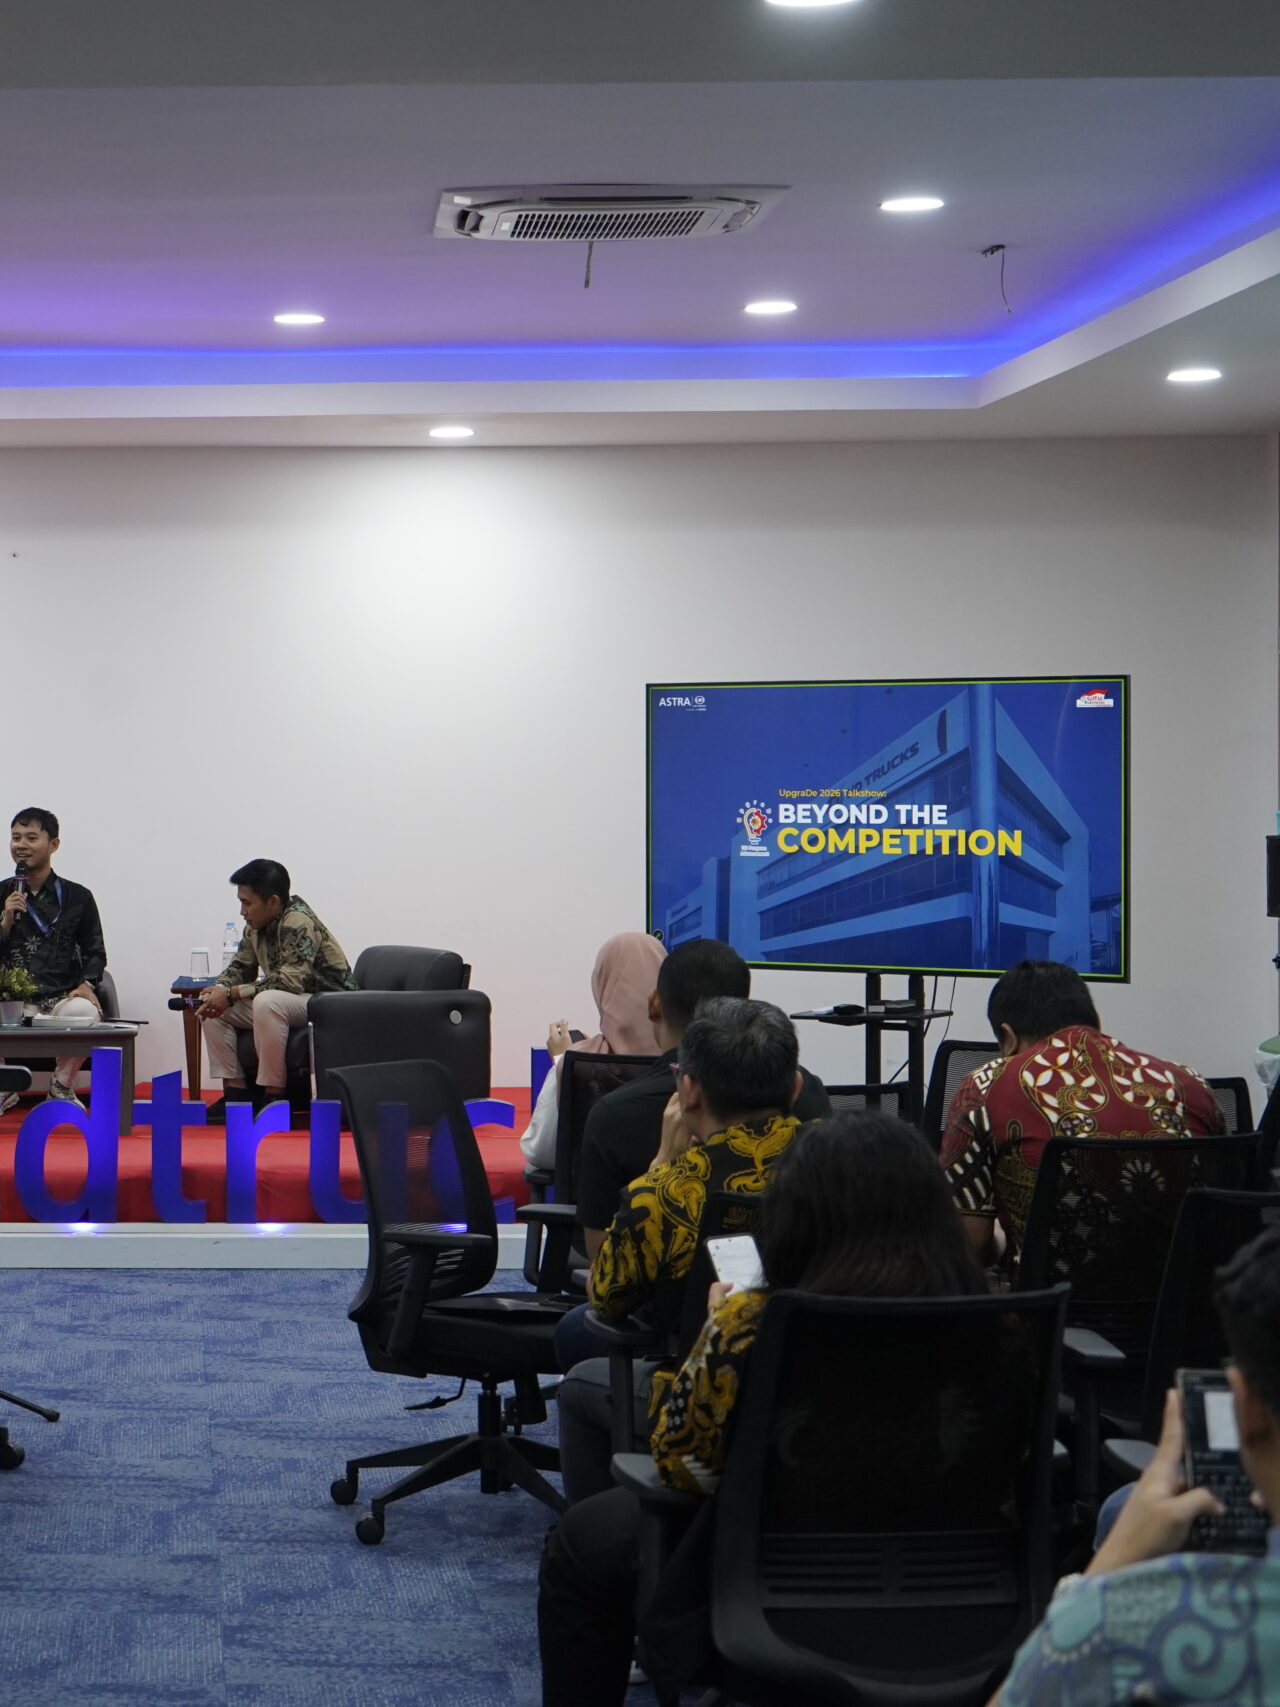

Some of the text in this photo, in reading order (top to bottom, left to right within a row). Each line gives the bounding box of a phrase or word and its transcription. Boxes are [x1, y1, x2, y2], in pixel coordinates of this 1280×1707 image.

[659, 697, 691, 707] ASTRA
[864, 741, 919, 786] TRUCKS
[779, 788, 887, 799] UpgraDe 2026 Talkshow:
[778, 803, 889, 825] BEYOND
[895, 804, 948, 825] THE
[777, 827, 1023, 857] COMPETITION
